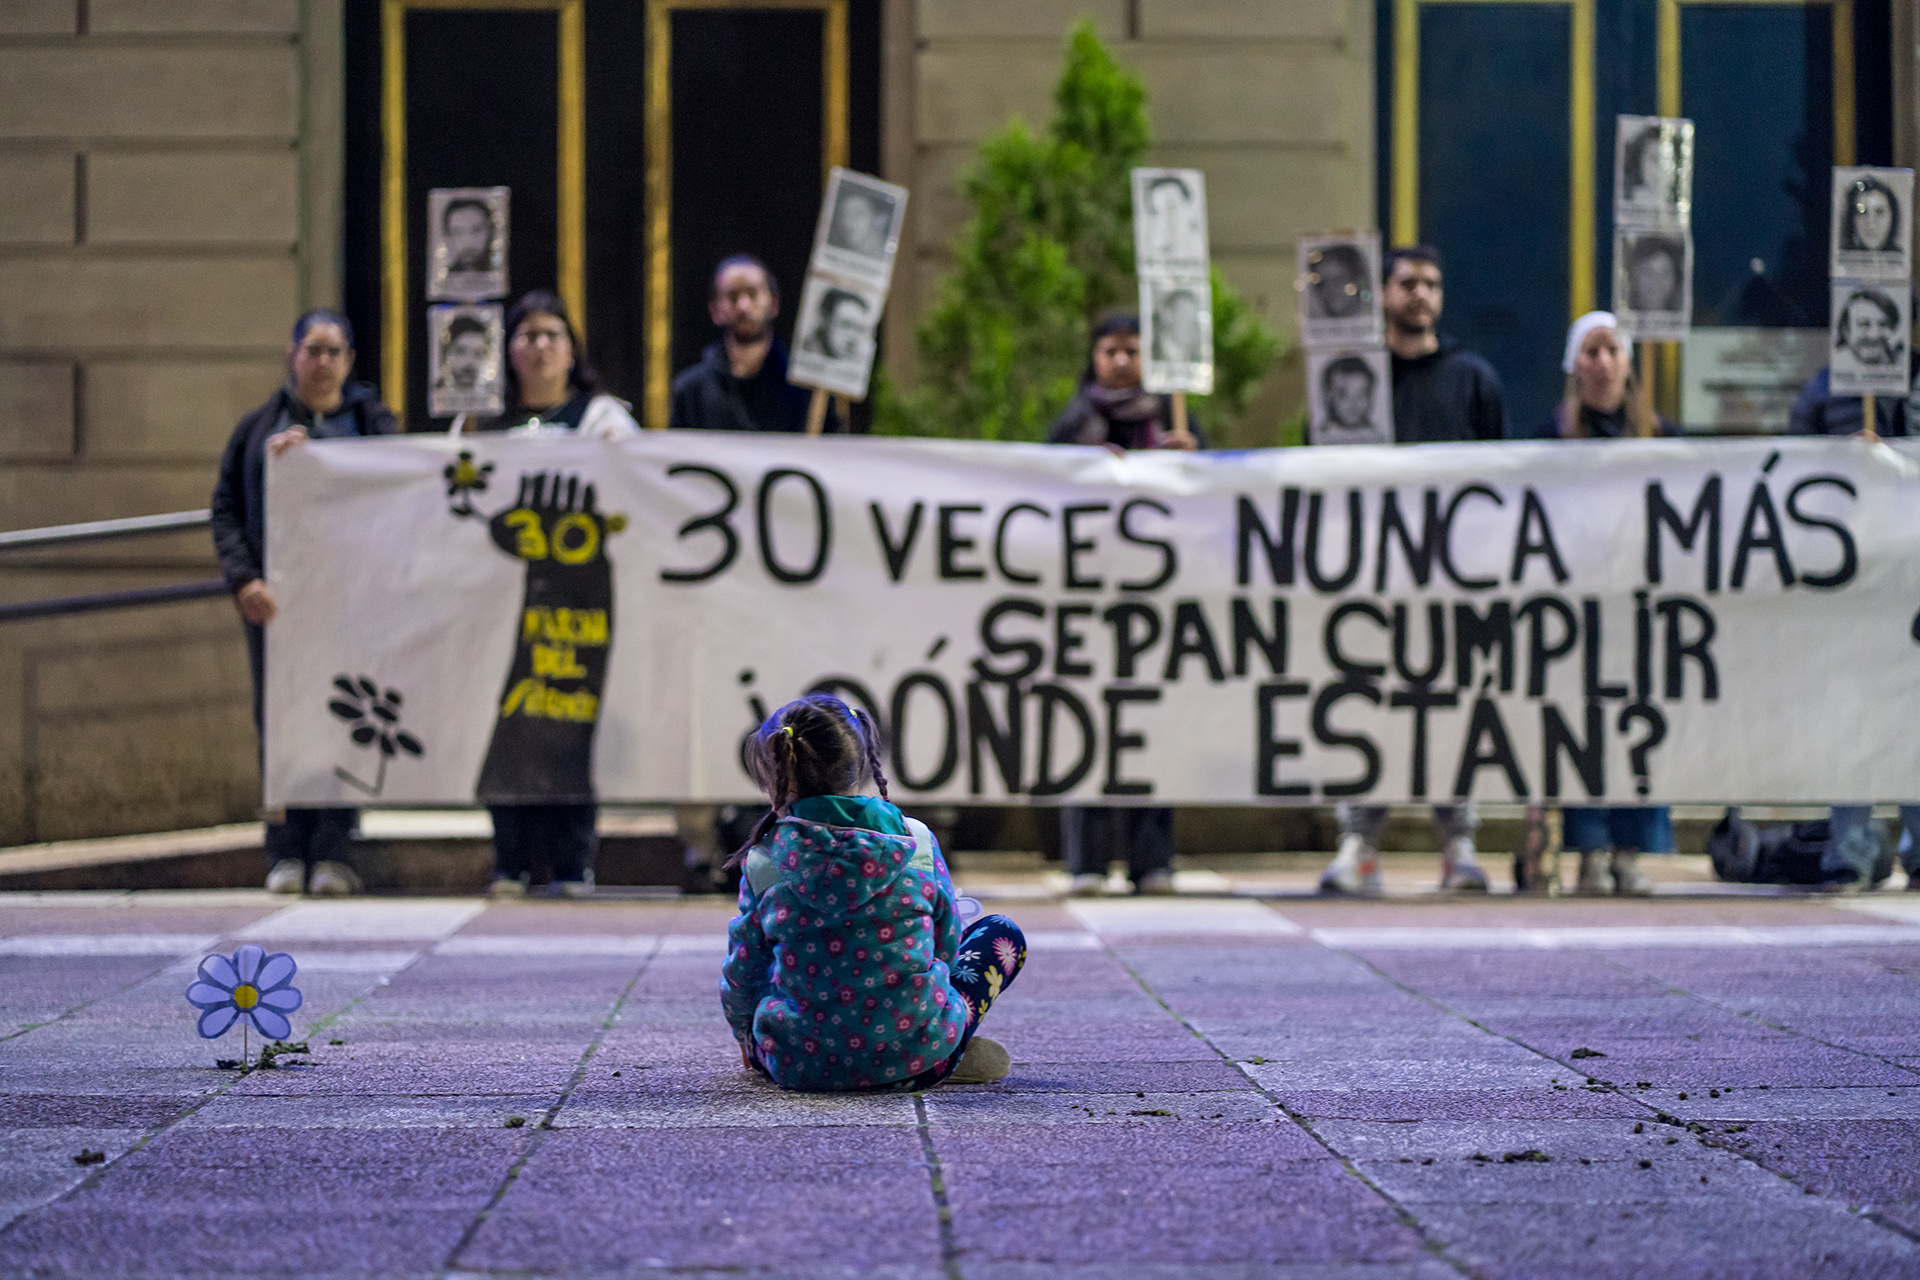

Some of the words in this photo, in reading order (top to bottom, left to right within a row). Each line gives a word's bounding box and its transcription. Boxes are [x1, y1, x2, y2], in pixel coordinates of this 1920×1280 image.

[504, 509, 599, 565] 30
[658, 463, 834, 587] 30
[869, 497, 1179, 593] VECES
[1235, 482, 1571, 596] NUNCA
[1643, 450, 1861, 597] MÁS
[971, 597, 1291, 683] SEPAN
[1322, 589, 1722, 702] CUMPLIR
[1256, 673, 1669, 799] ESTÁN?
